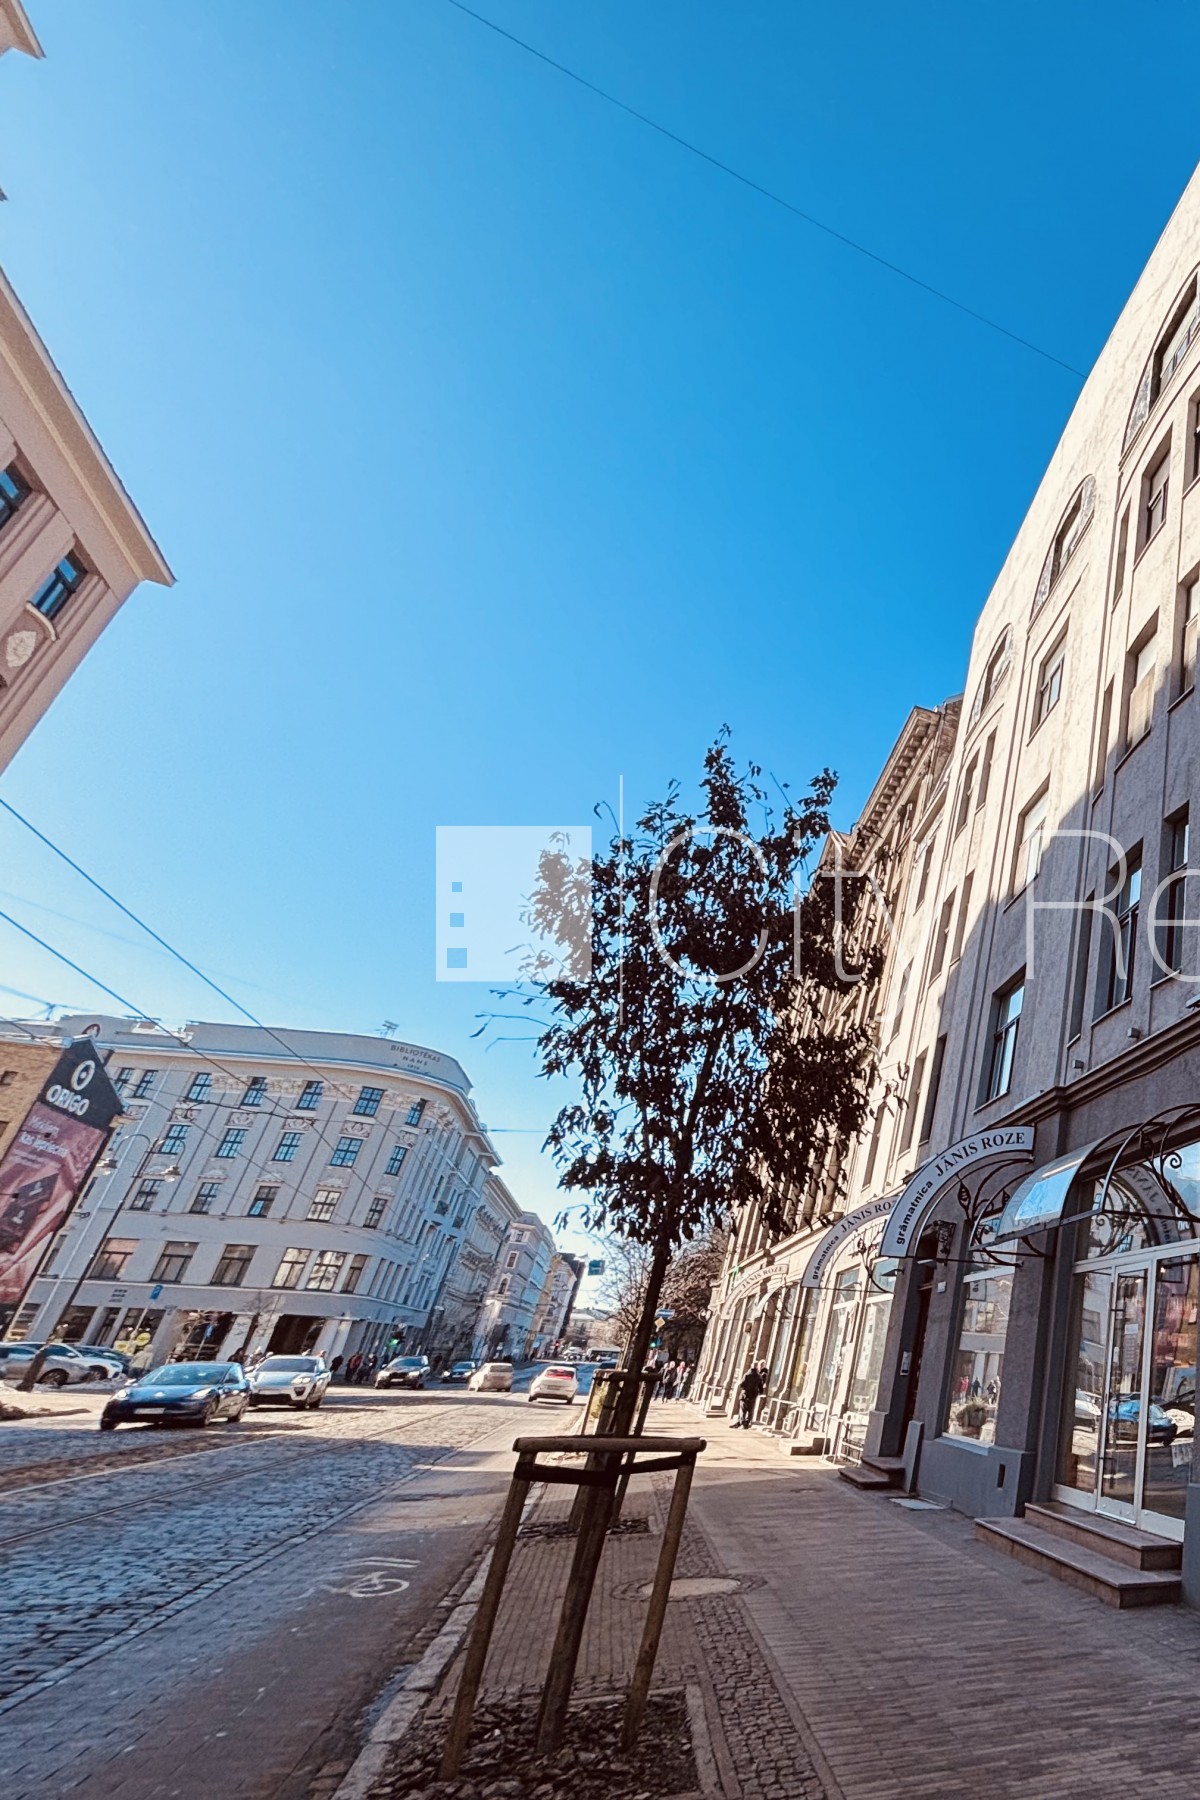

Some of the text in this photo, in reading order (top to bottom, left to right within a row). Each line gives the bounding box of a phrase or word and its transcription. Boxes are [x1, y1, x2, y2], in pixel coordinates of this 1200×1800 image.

[45, 1084, 90, 1116] ORIGO
[934, 1141, 978, 1177] JĀNIS
[981, 1132, 1025, 1150] ROZE
